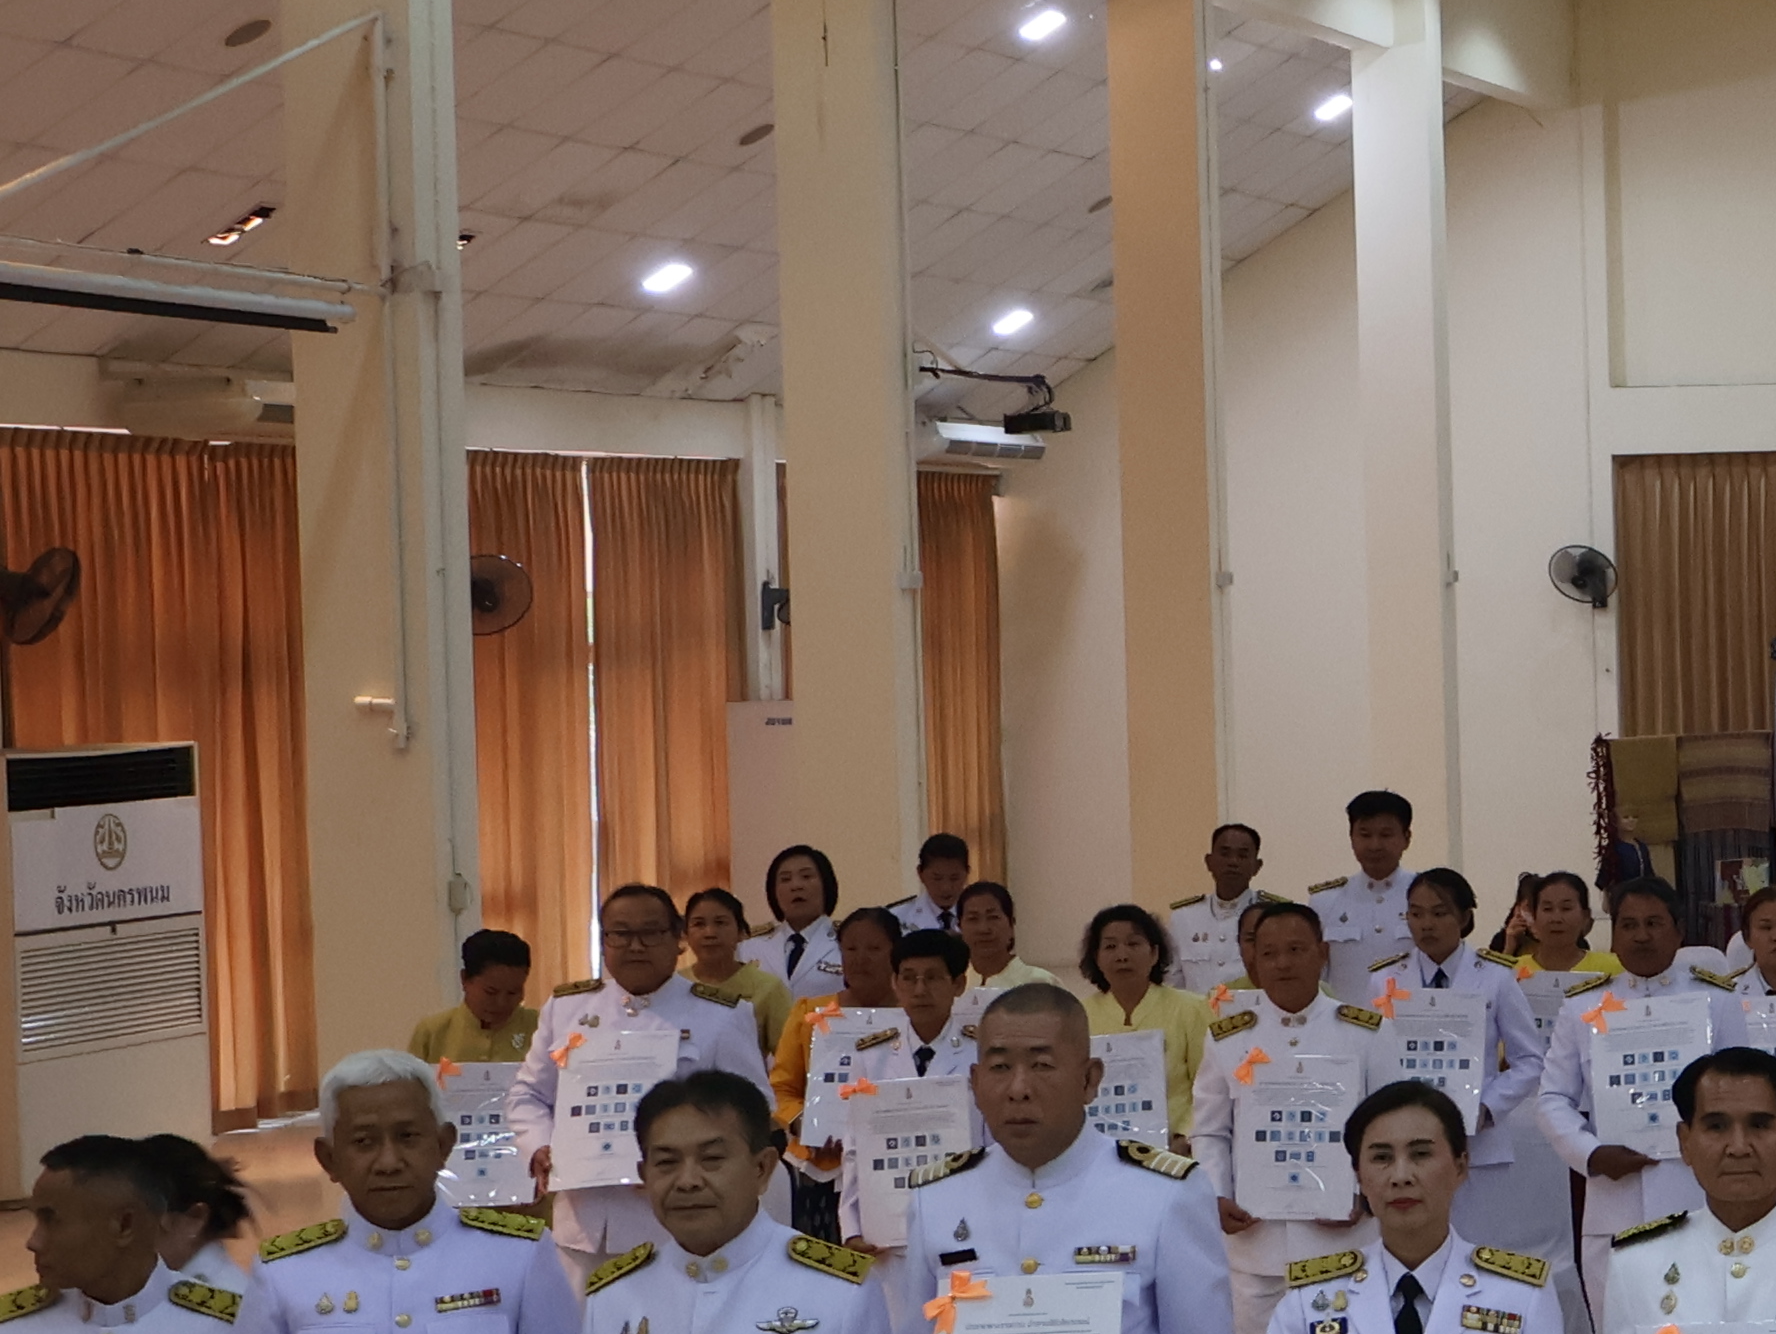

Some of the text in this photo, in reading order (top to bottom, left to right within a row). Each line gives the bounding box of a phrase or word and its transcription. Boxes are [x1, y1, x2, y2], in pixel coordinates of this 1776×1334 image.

[55, 881, 171, 915] จังหวัดนครพนม
